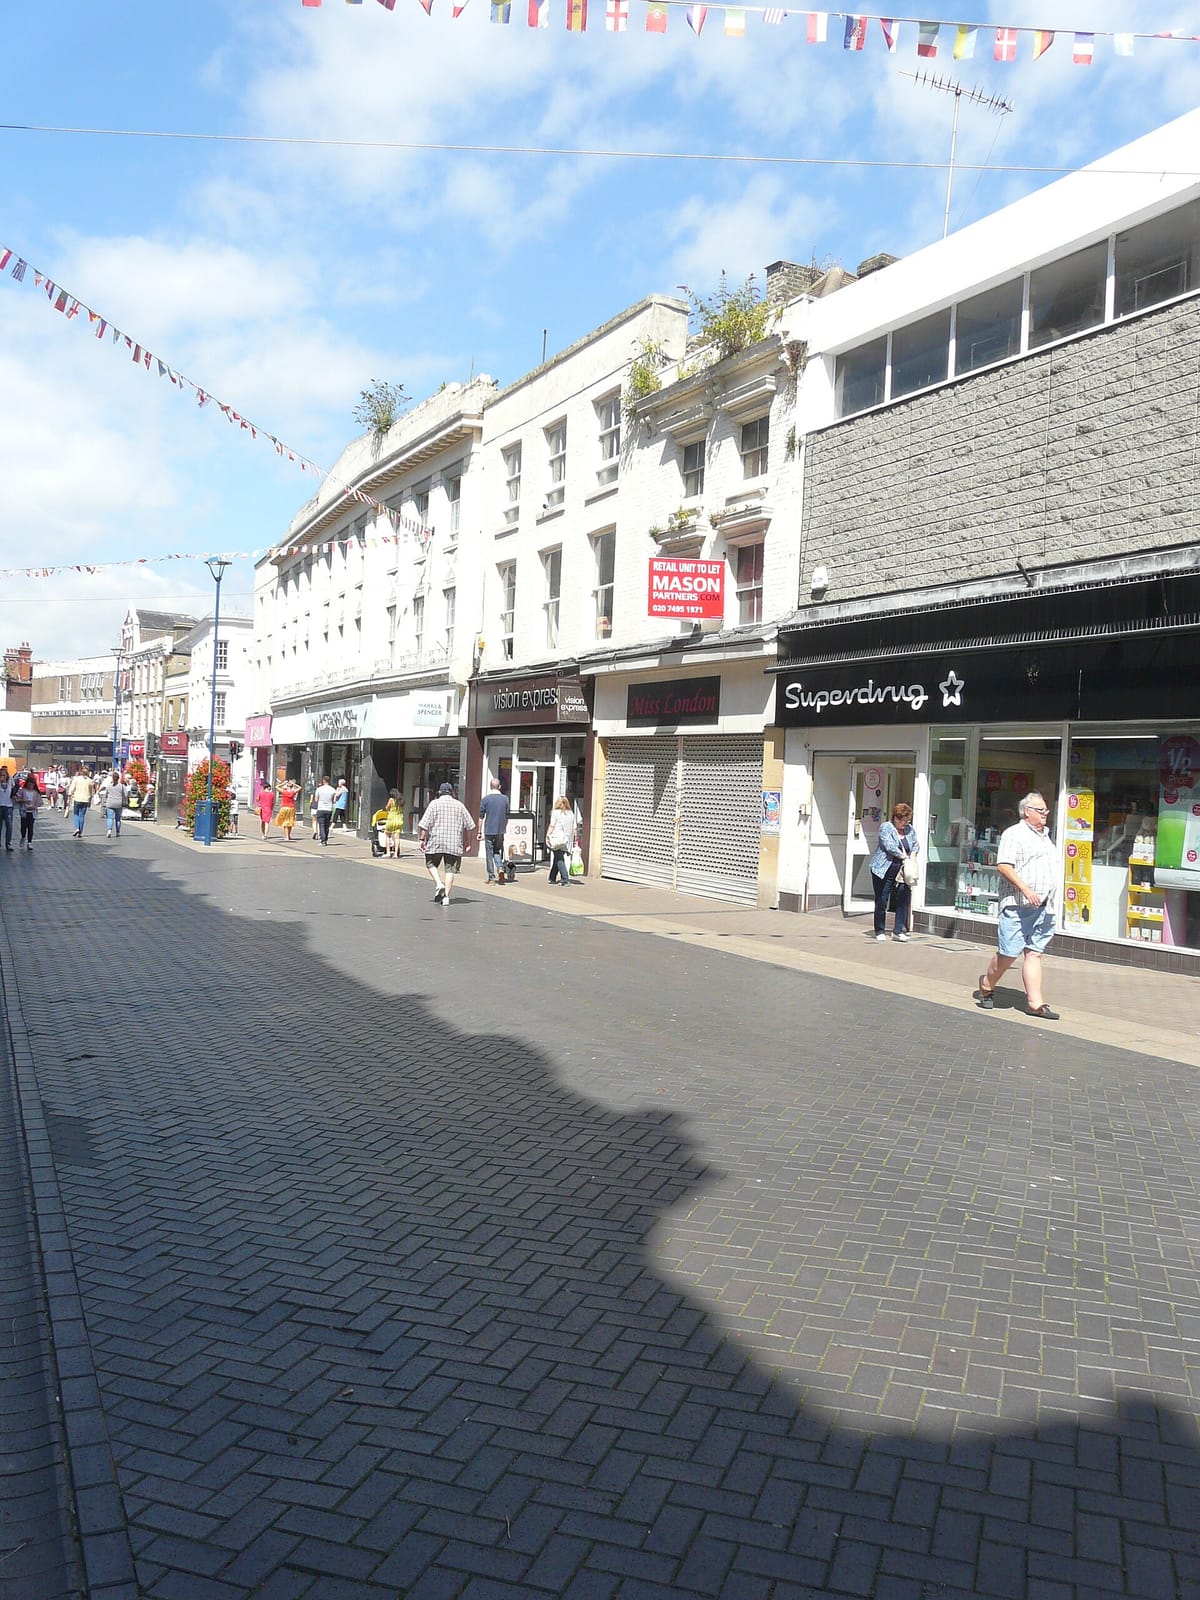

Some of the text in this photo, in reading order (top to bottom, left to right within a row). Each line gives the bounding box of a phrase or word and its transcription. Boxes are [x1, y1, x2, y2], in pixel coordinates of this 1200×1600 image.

[653, 561, 721, 575] RETAIL UNIT TO LET
[652, 575, 721, 593] MASON
[652, 591, 720, 601] PARTNERS.COM
[652, 604, 666, 612] 020
[493, 687, 520, 710] vision
[564, 695, 585, 705] vision
[630, 687, 717, 716] Miss London
[785, 679, 929, 713] Superdrug
[560, 704, 588, 713] express
